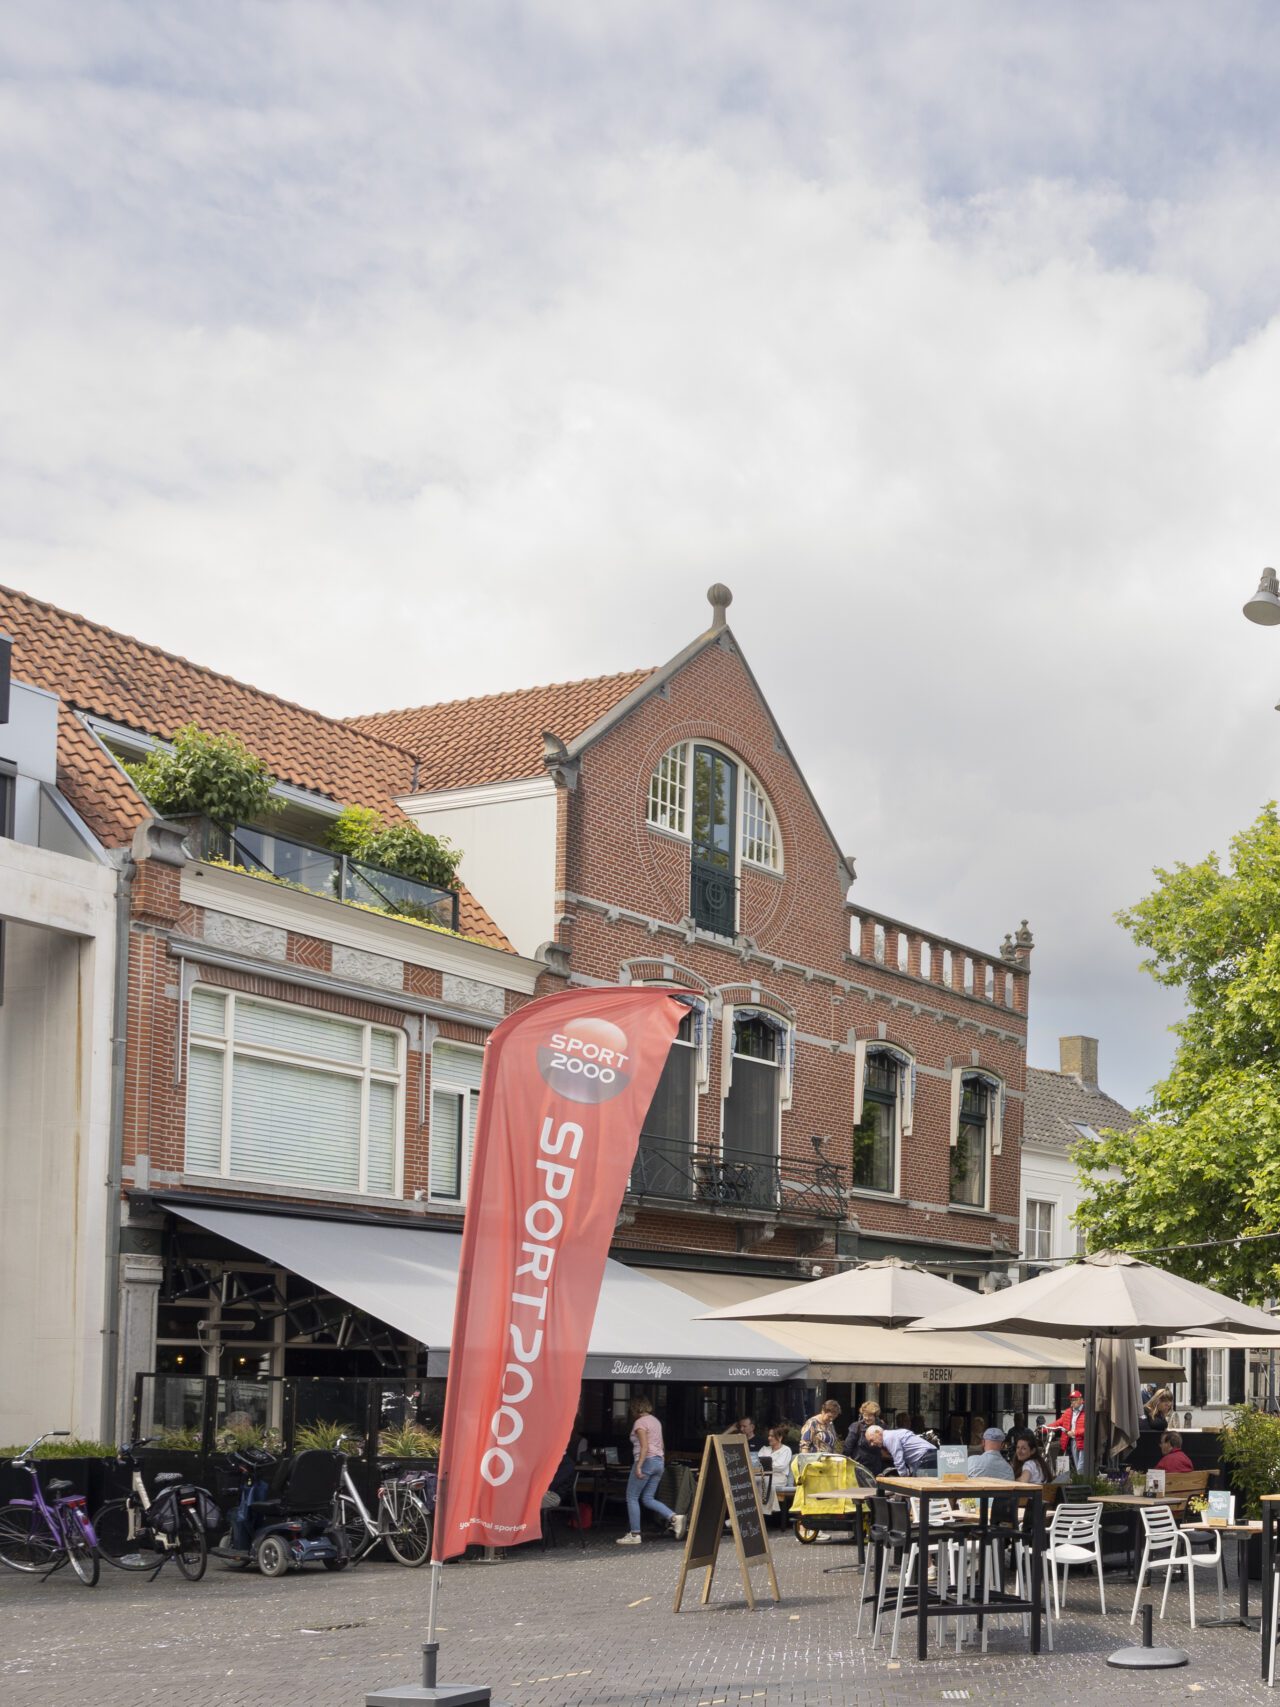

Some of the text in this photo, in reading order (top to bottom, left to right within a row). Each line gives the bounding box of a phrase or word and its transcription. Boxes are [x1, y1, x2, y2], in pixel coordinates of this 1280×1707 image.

[549, 1033, 629, 1068] SPORT
[549, 1052, 616, 1084] 2000
[644, 1361, 673, 1379] Coffee
[728, 1368, 780, 1377] LUNCH BORREL
[929, 1368, 953, 1381] BEREN
